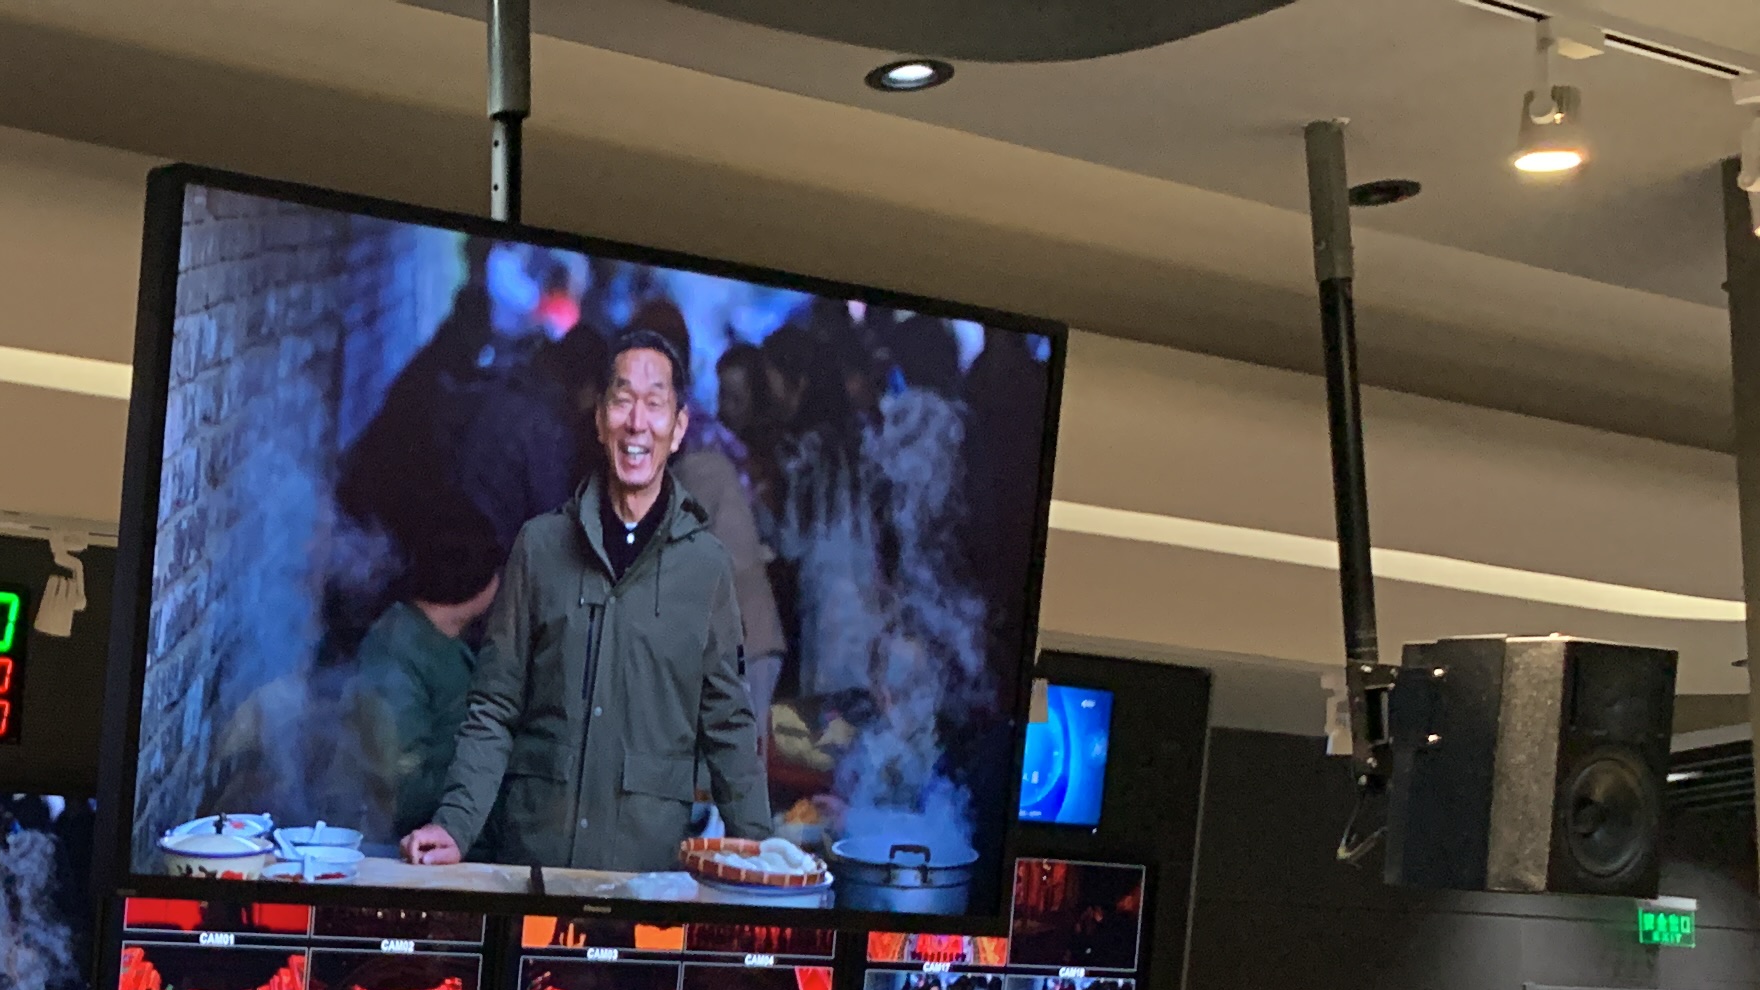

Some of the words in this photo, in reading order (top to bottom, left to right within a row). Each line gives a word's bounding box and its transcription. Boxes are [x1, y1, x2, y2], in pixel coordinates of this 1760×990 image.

[199, 931, 234, 946] CAM01
[380, 939, 415, 954] CAM02
[586, 947, 618, 962] CAM03
